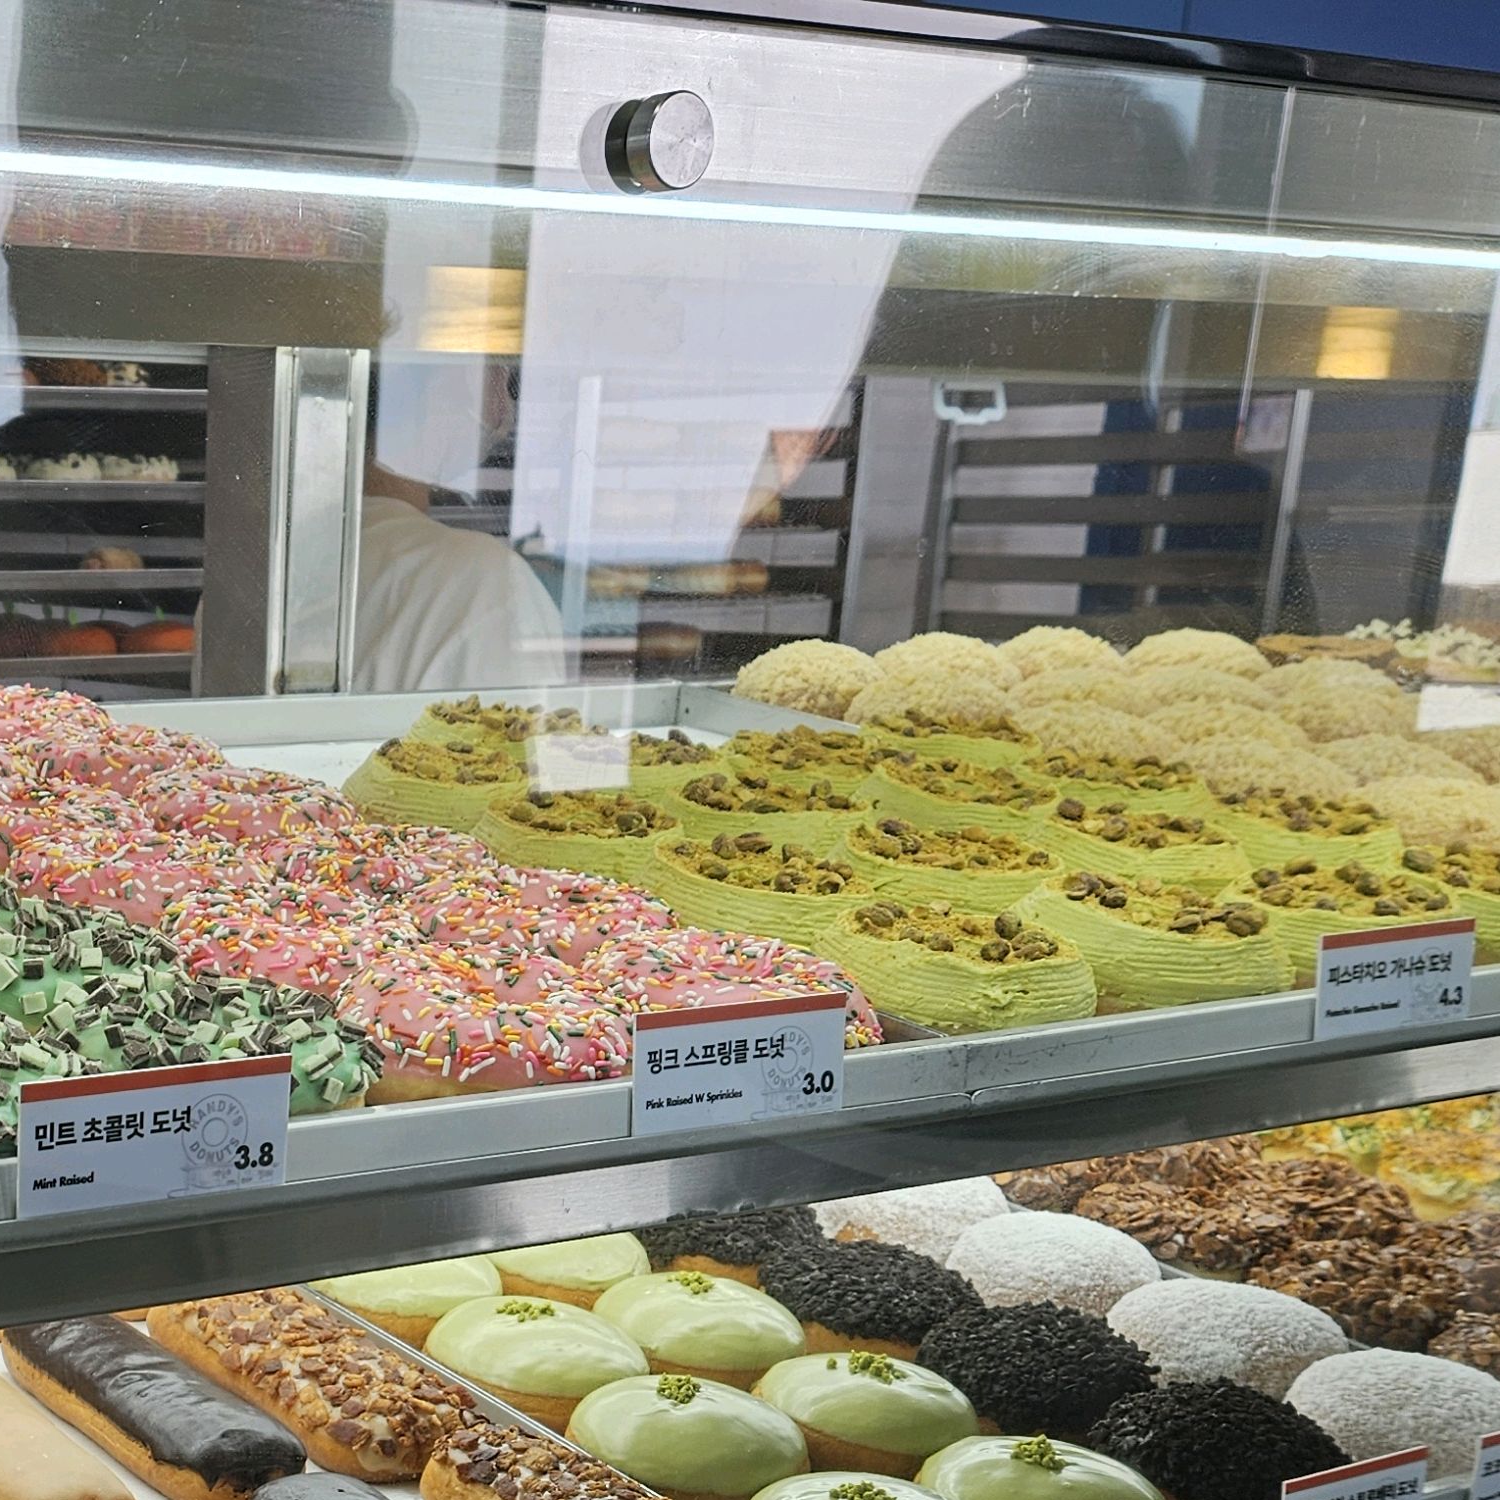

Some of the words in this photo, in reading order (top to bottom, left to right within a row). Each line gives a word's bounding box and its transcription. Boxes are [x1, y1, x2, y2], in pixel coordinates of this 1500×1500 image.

[1327, 961, 1388, 986] 피스타치오
[1438, 985, 1464, 1007] 4.3
[647, 1048, 680, 1075] 핑크
[684, 1039, 750, 1067] 스프링클
[753, 1034, 785, 1059] 도넛
[802, 1070, 835, 1095] 3.0
[646, 1099, 664, 1110] Pink
[666, 1096, 694, 1107] Raised
[695, 1093, 705, 1103] W
[35, 1121, 77, 1150] 민트
[81, 1111, 145, 1144] 초콜릿
[150, 1106, 192, 1135] 도넛
[234, 1142, 275, 1170] 3.8
[32, 1177, 57, 1191] Mint
[59, 1171, 94, 1187] Raised
